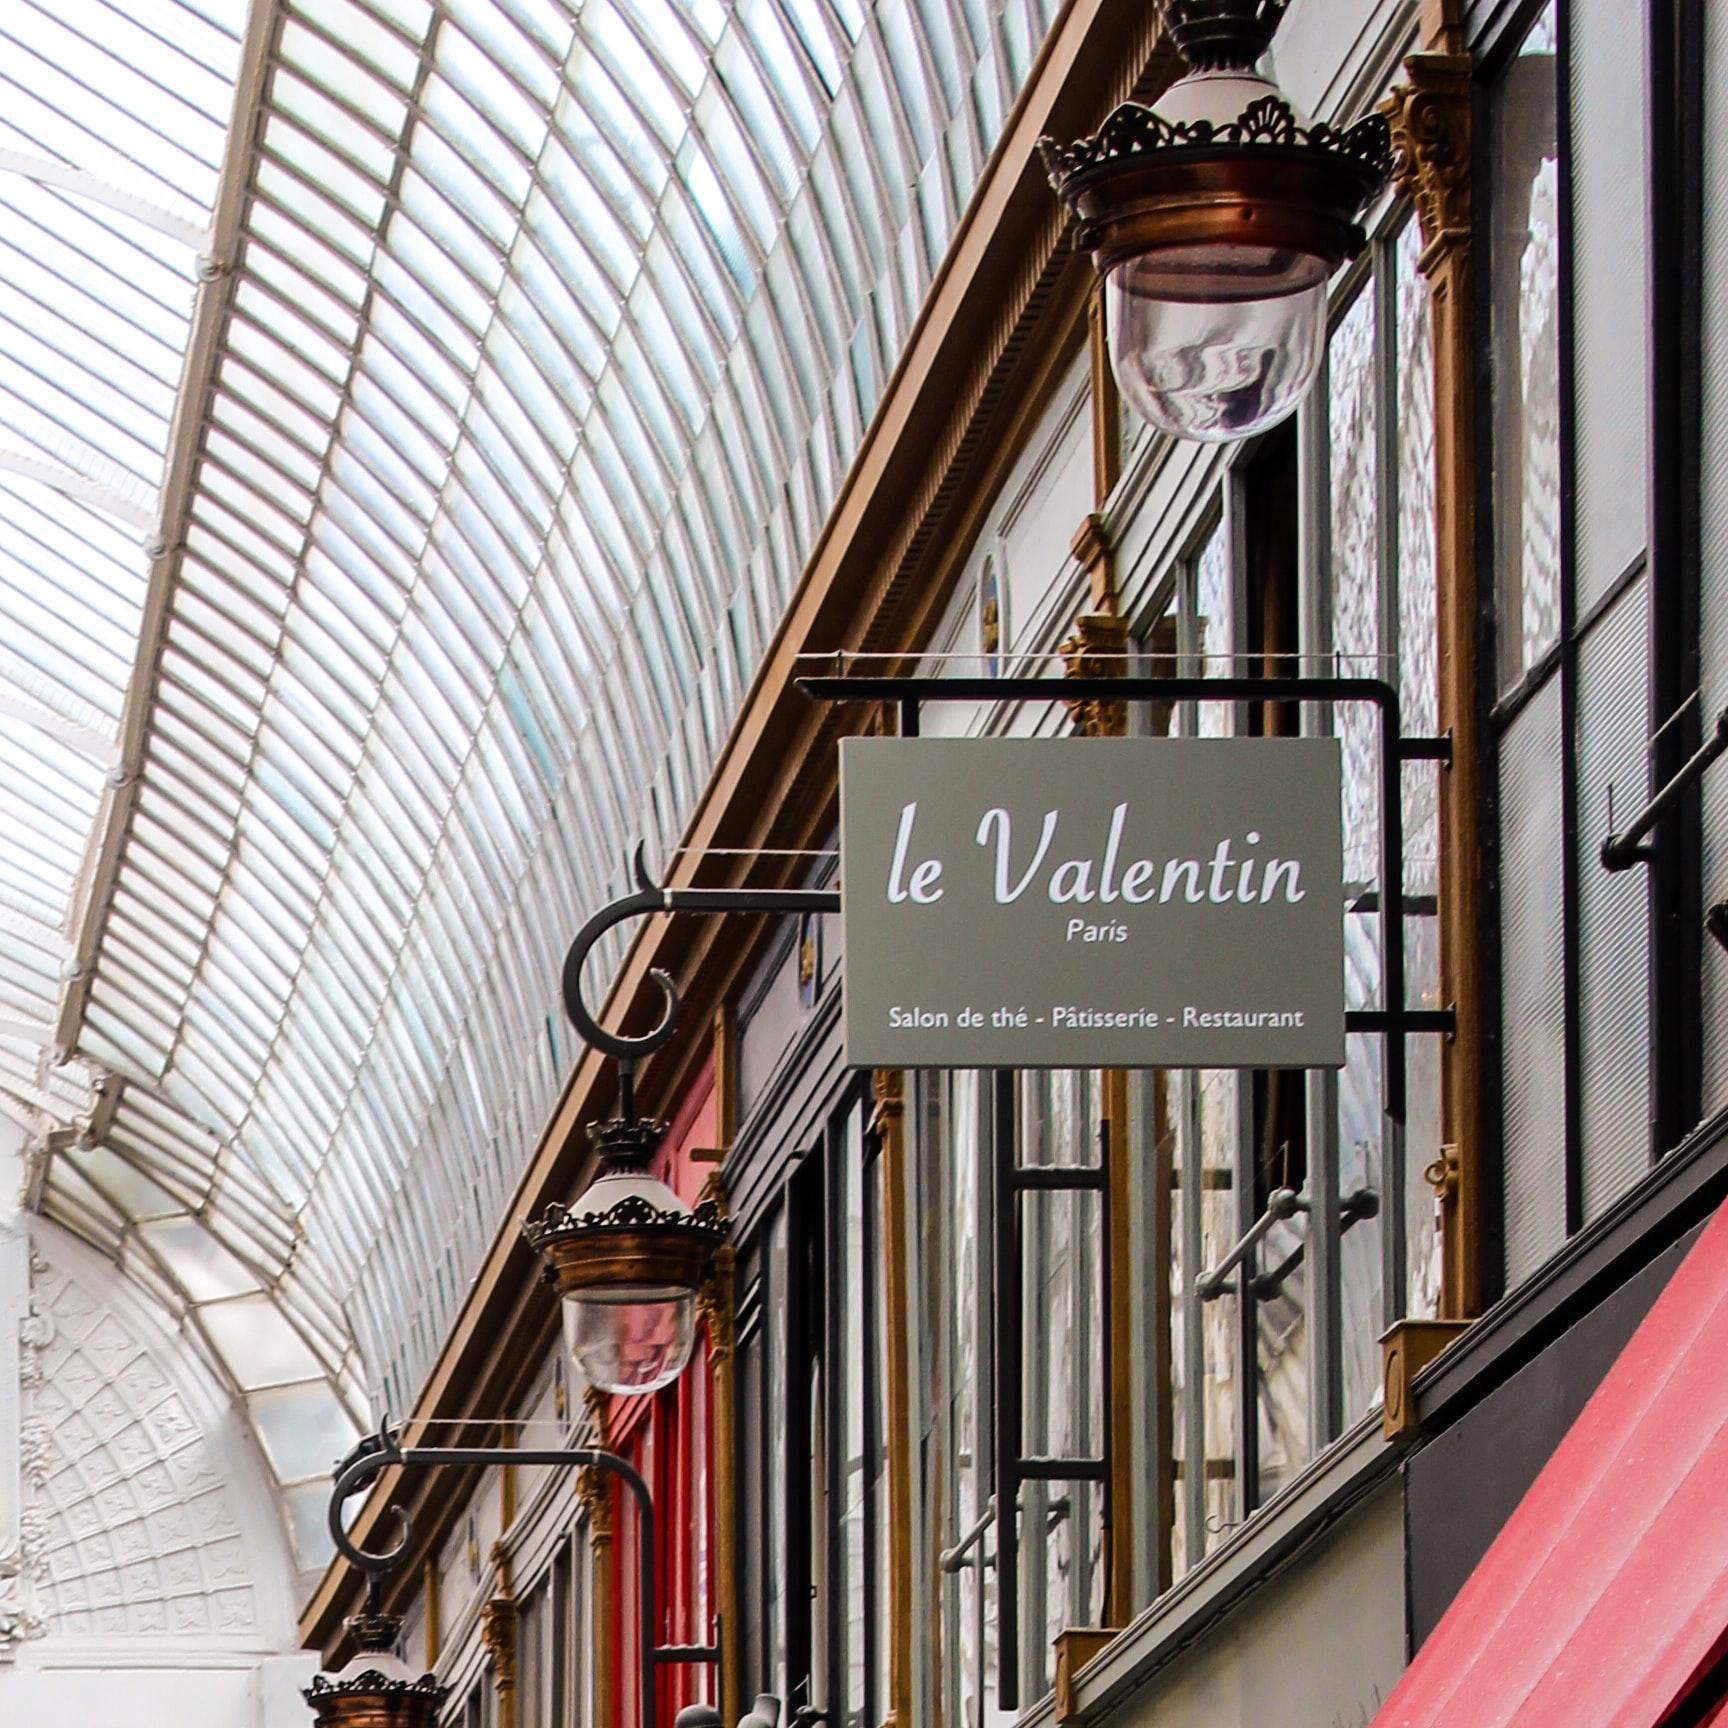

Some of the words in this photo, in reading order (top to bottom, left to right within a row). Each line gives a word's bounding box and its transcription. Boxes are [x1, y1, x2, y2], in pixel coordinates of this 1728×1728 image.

[886, 801, 945, 904] le
[975, 801, 1306, 905] Valentin
[1066, 918, 1128, 943] Paris
[889, 1006, 948, 1028] Salon
[956, 1006, 984, 1028] de
[990, 1006, 1028, 1028] thé
[1052, 1005, 1159, 1028] Pâtisserie
[1183, 1006, 1304, 1028] Restaurant
